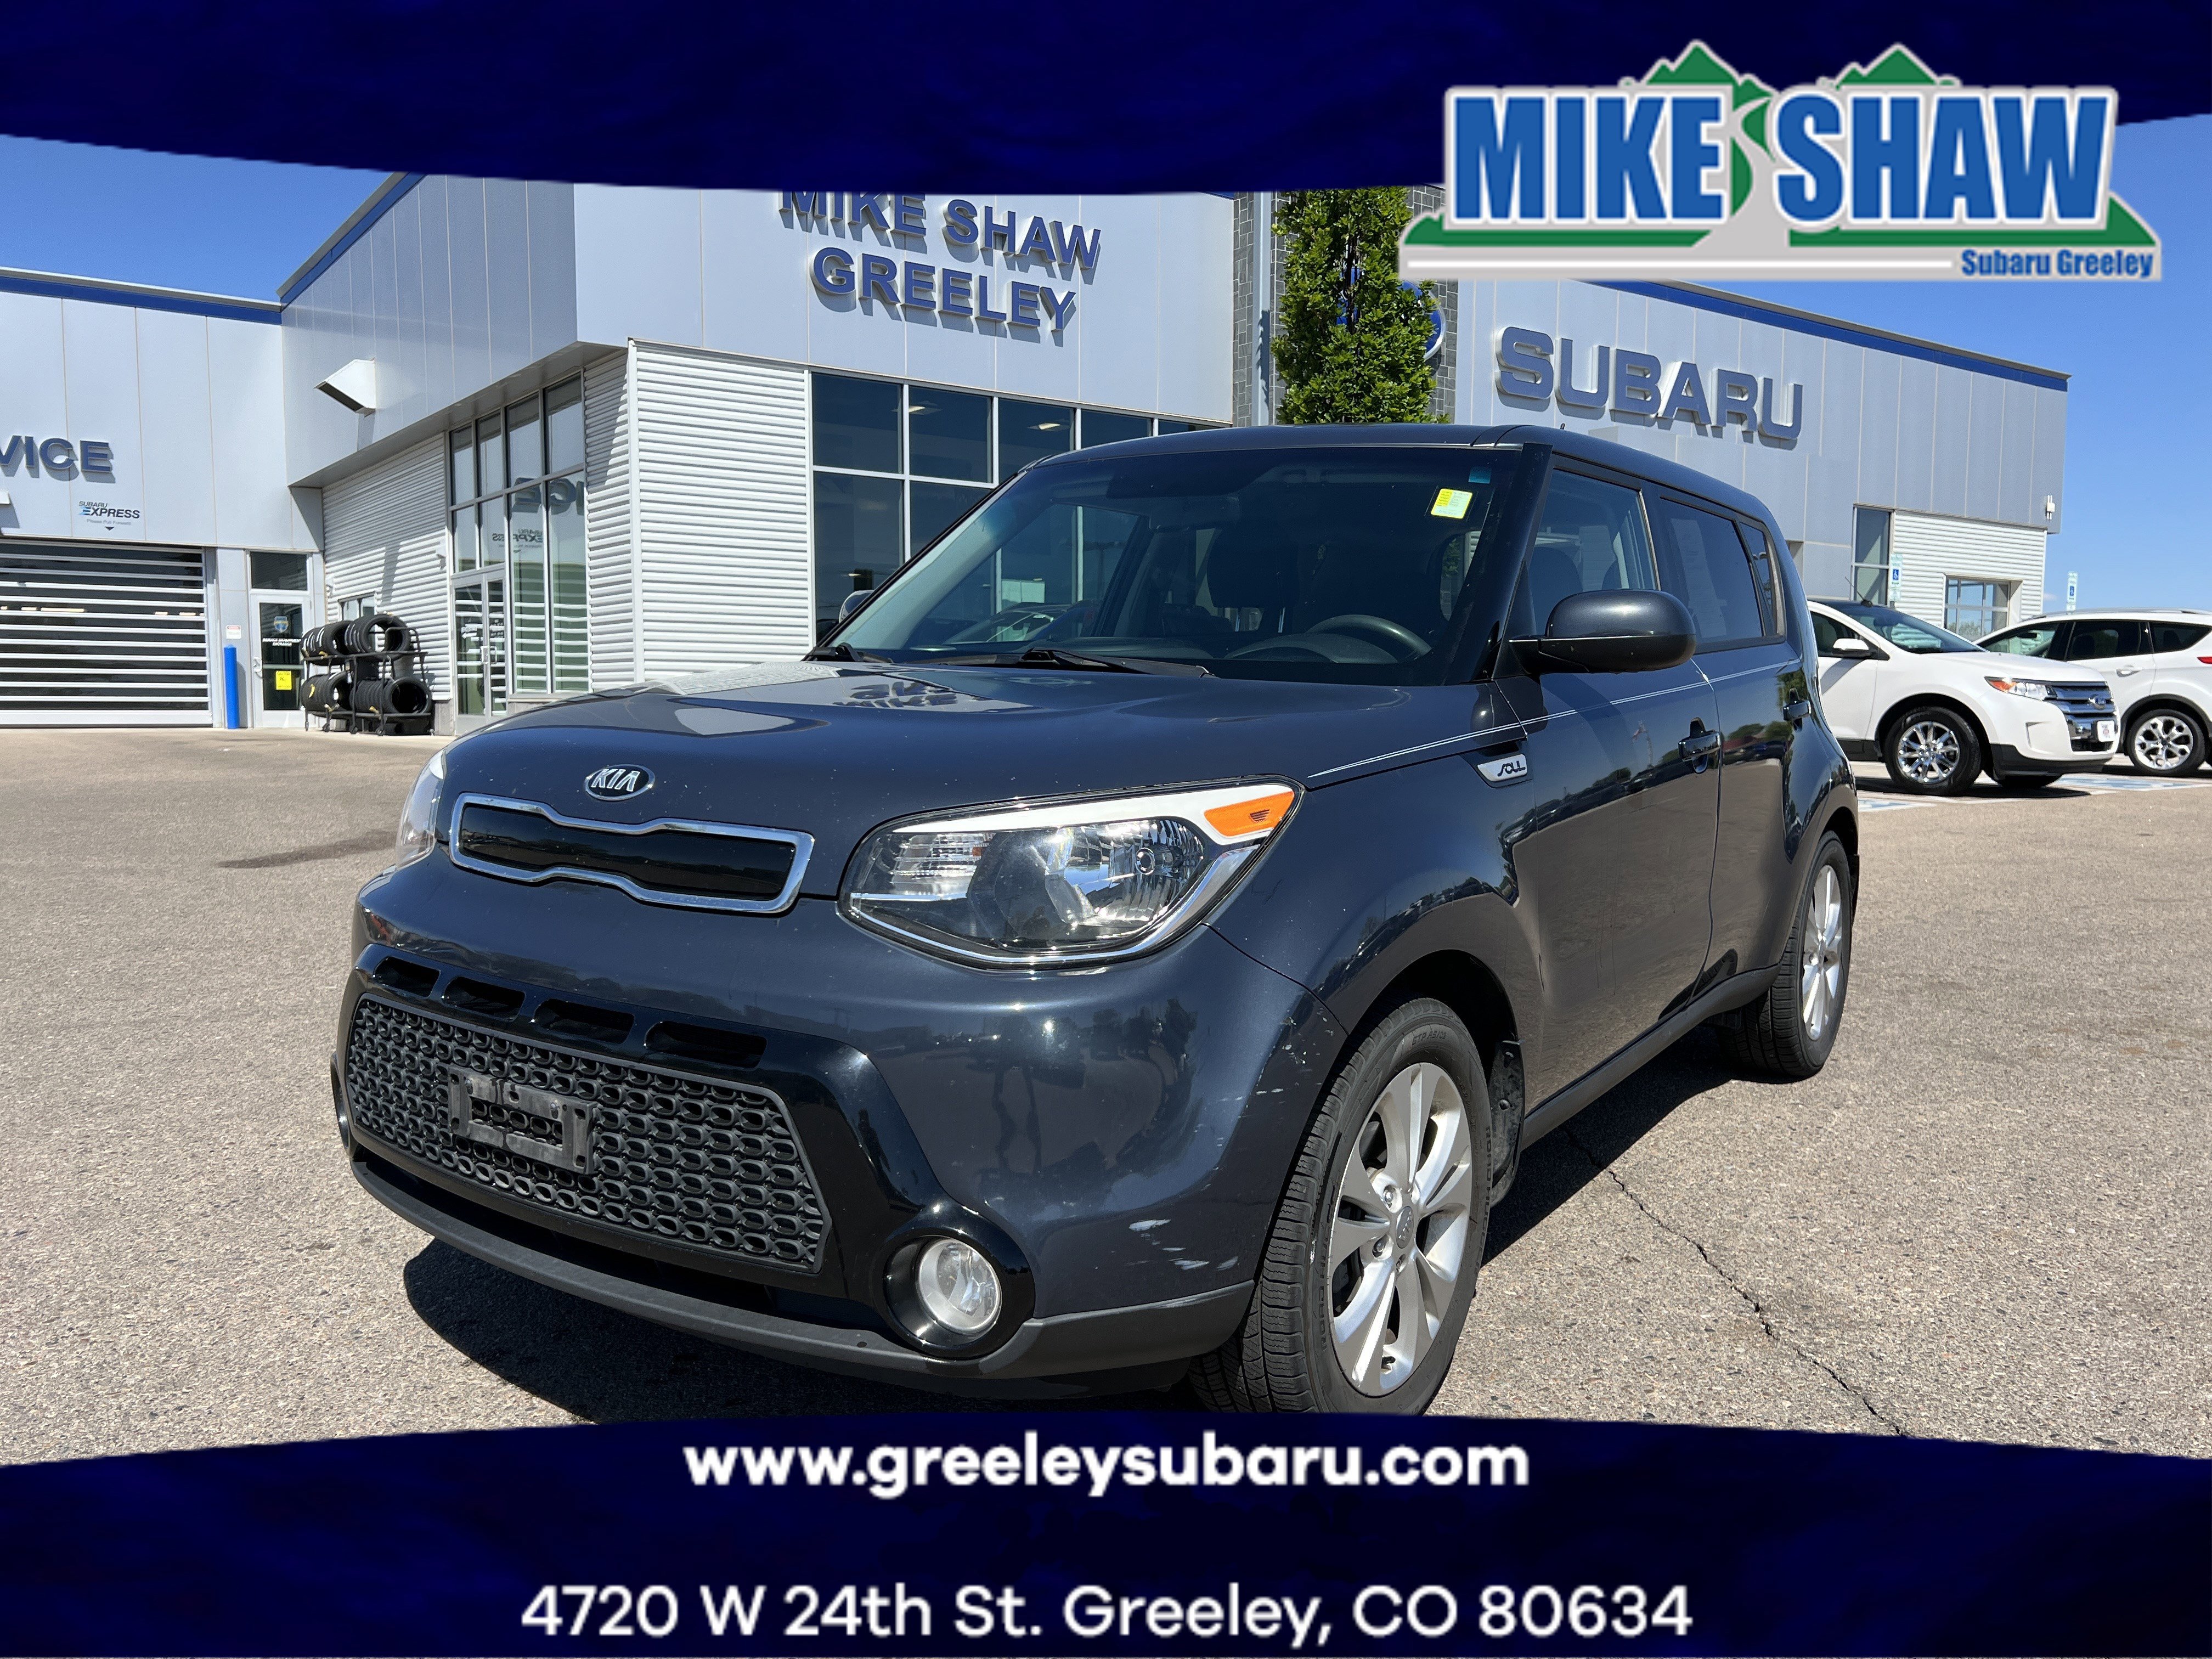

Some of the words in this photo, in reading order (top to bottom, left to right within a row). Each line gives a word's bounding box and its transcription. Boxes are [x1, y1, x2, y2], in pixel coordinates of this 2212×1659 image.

[943, 199, 1101, 269] SHAW
[810, 247, 1076, 331] GREELEY
[1494, 326, 1803, 439] SUBARU
[80, 507, 140, 518] EXPRESS
[591, 769, 641, 792] KIA
